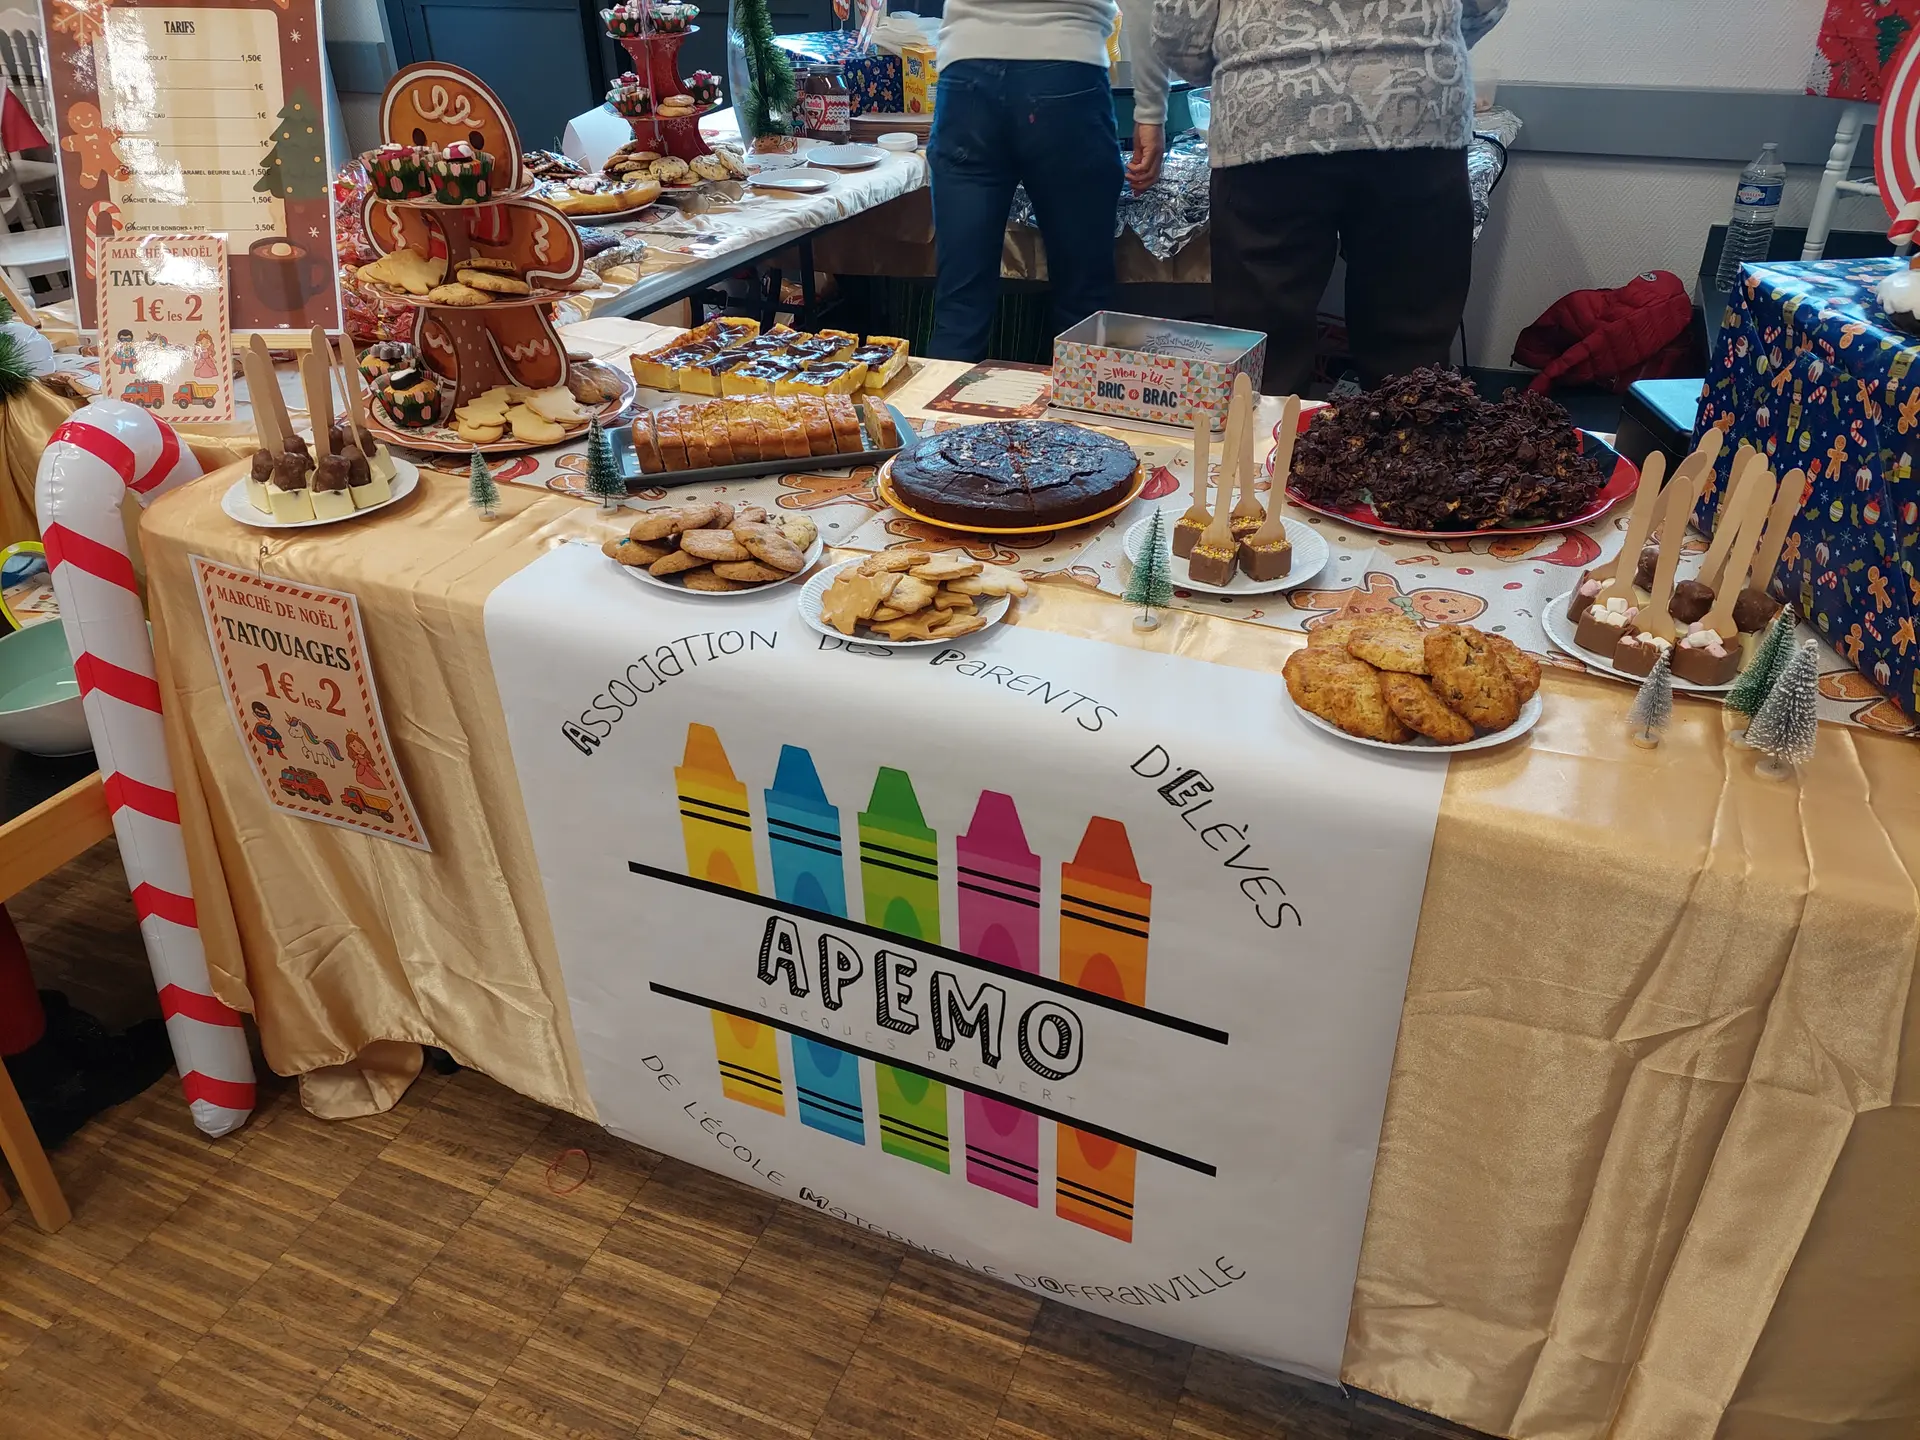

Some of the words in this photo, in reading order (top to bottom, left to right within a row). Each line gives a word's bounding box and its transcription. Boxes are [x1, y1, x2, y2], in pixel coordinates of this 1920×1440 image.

[164, 21, 196, 34] TARIFS
[241, 54, 262, 63] 1,50€
[254, 83, 264, 91] 1€
[231, 168, 247, 176] SALÉ
[252, 196, 273, 204] 1,50€
[255, 223, 275, 232] 3,50€
[111, 245, 161, 259] MARHÉ
[182, 244, 213, 258] NOËL
[132, 296, 165, 322] 1€
[167, 310, 183, 322] les
[184, 294, 203, 322] 2
[1111, 367, 1138, 378] Mon
[1097, 380, 1125, 400] BRIC
[1143, 387, 1178, 408] BRAC
[215, 584, 274, 614] MARCHÉ
[274, 601, 297, 620] DE
[298, 606, 339, 630] NOËL
[220, 615, 352, 671] TATOUAGES
[256, 662, 300, 704] 1€
[301, 691, 322, 711] les
[318, 677, 347, 718] 2
[757, 914, 1084, 1081] APEMO
[926, 1049, 1077, 1106] PREVERT
[640, 1054, 682, 1092] DE
[683, 1101, 787, 1187] L'ÉCOLE
